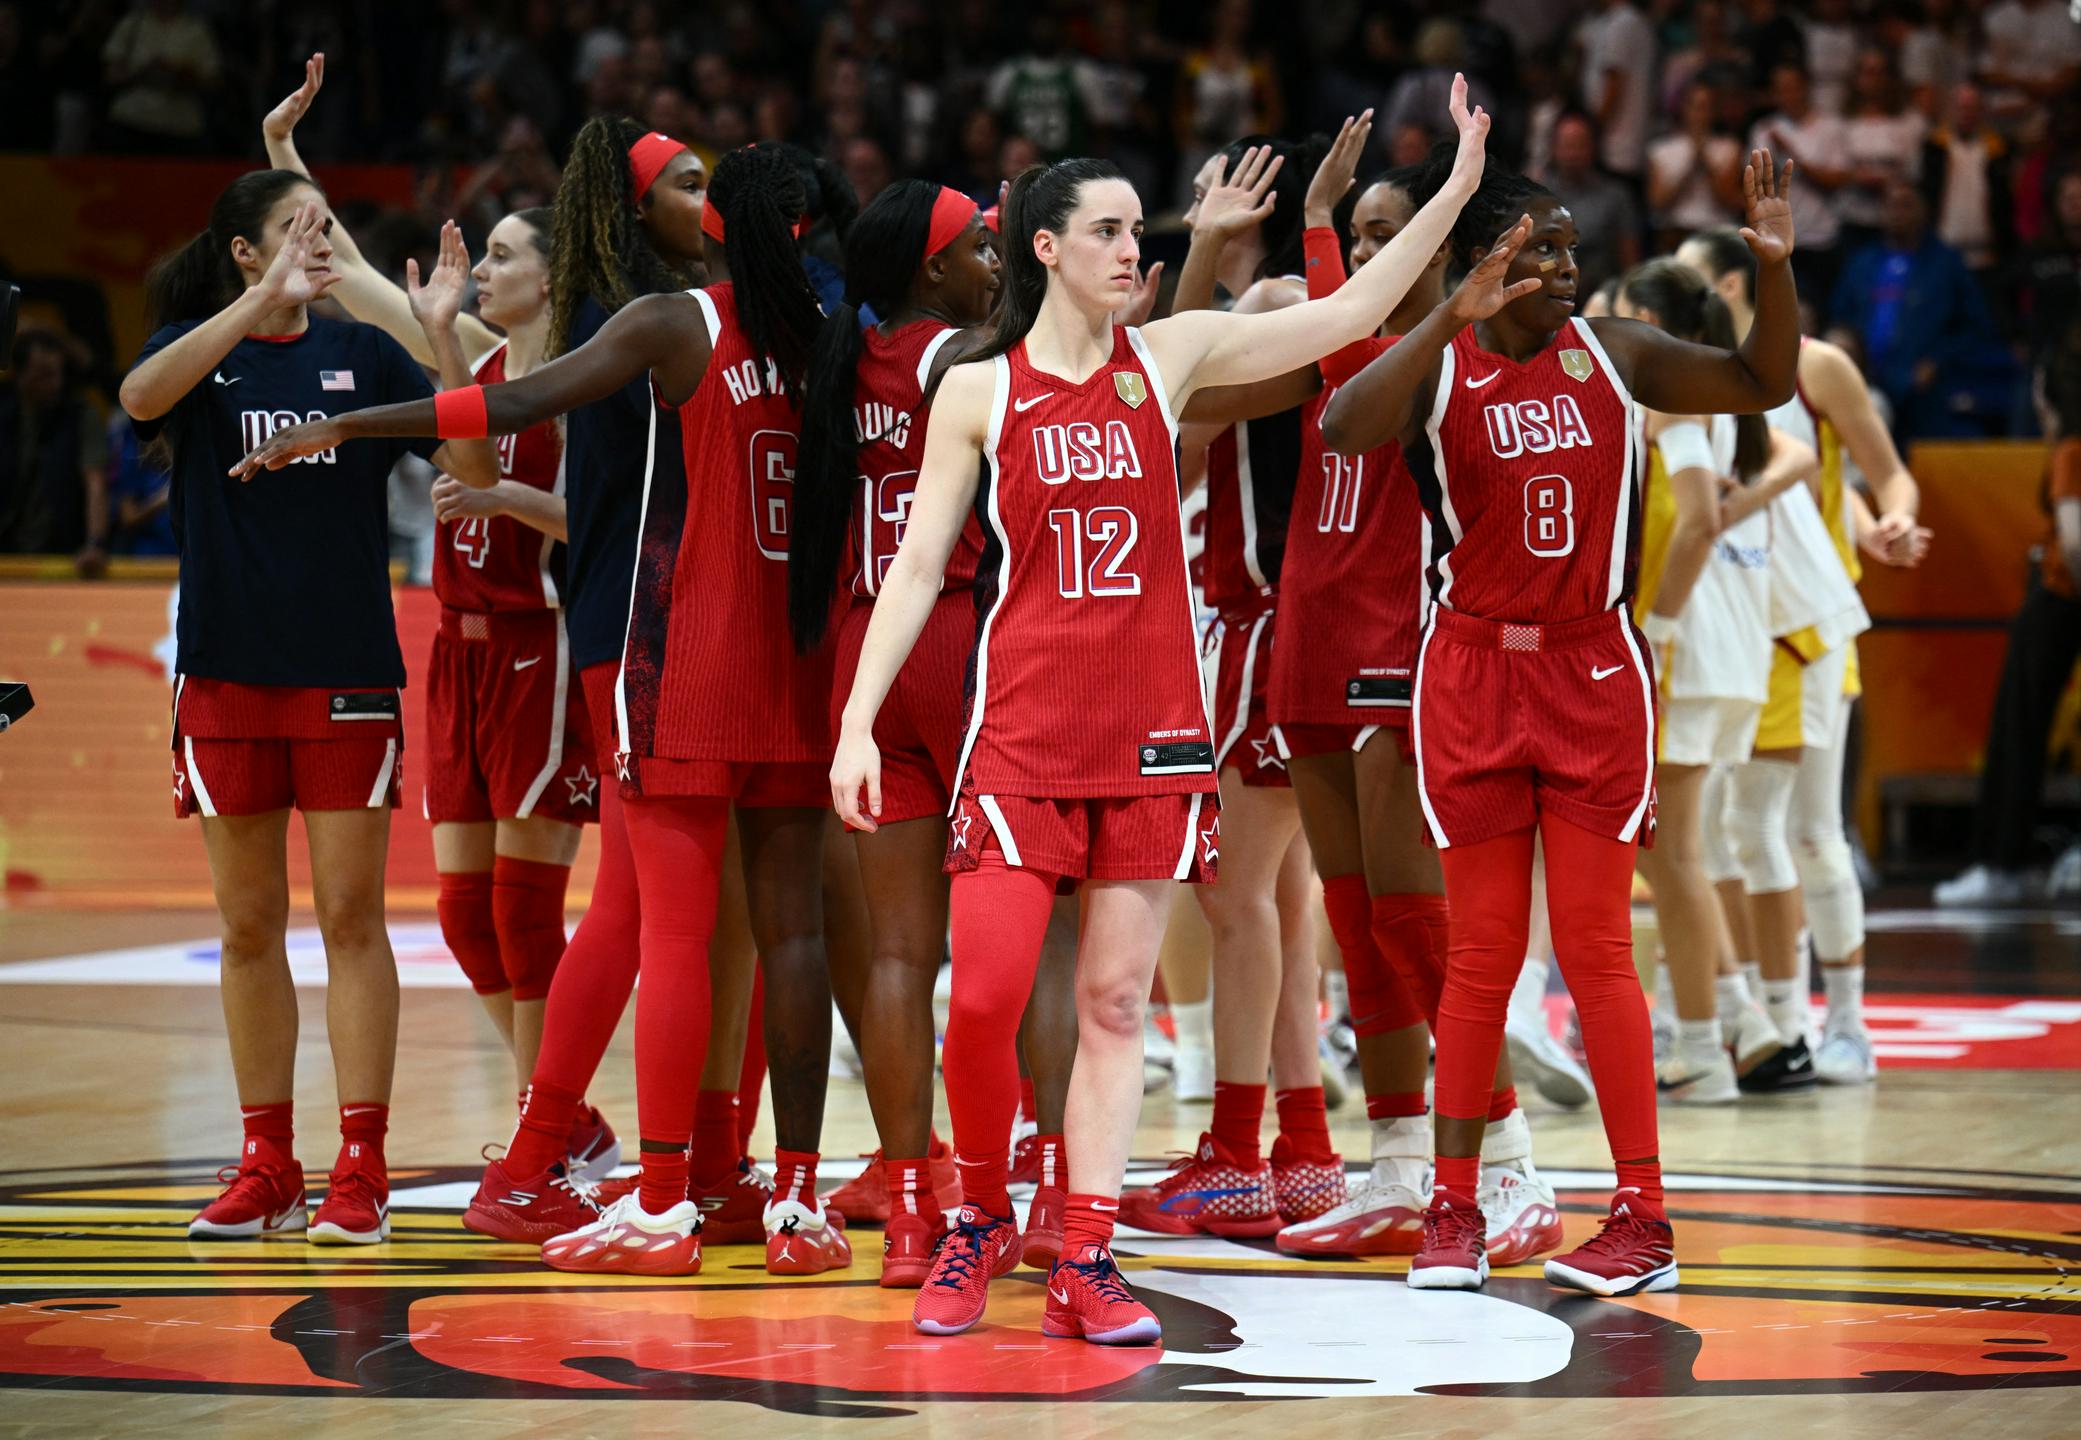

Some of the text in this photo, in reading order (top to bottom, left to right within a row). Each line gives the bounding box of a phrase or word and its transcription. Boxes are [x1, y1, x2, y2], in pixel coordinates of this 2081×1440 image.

[1032, 421, 1142, 485] USA
[1484, 394, 1593, 459] USA
[750, 429, 800, 561] 6
[1318, 453, 1363, 532] 11
[1524, 474, 1574, 557] 8
[453, 517, 490, 568] 4
[1049, 506, 1141, 598] 12
[1149, 728, 1200, 739] EMBERS OF DYNASTY
